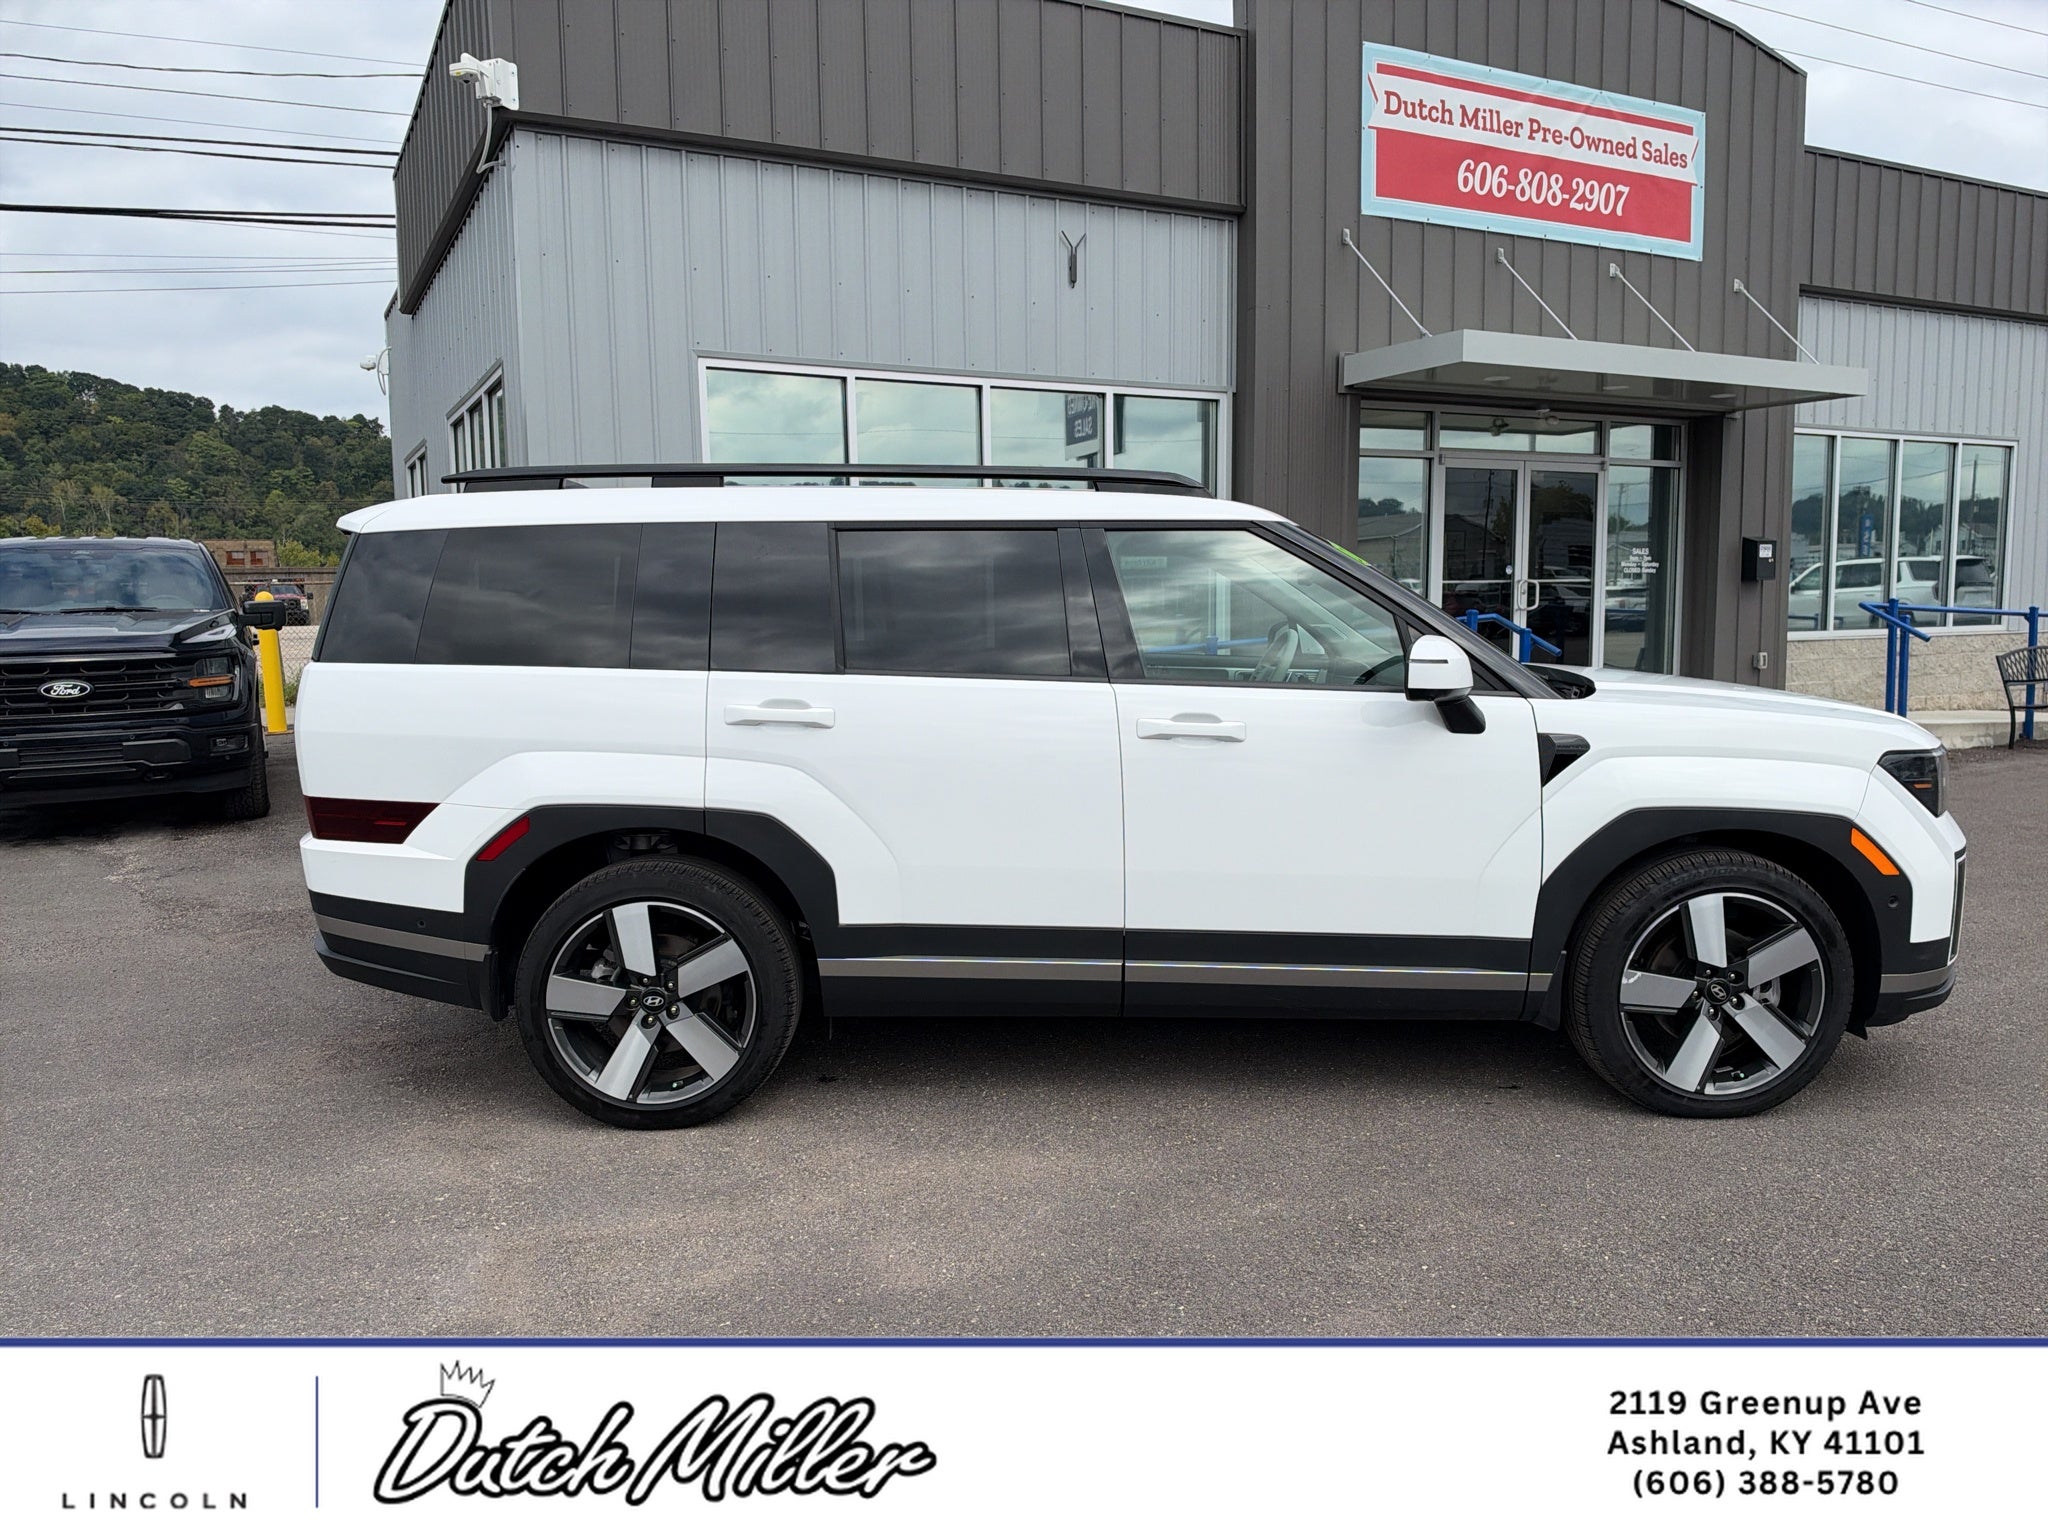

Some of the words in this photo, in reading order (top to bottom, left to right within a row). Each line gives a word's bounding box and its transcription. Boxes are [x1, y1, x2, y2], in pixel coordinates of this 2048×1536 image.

[1384, 90, 1455, 126] Dutch
[1459, 104, 1524, 138] Miller
[1527, 117, 1638, 160] Pre-Owned
[1642, 140, 1688, 169] Sales
[1457, 158, 1630, 217] 606-808-2907
[1632, 547, 1649, 555] SALES
[50, 684, 81, 696] Ford
